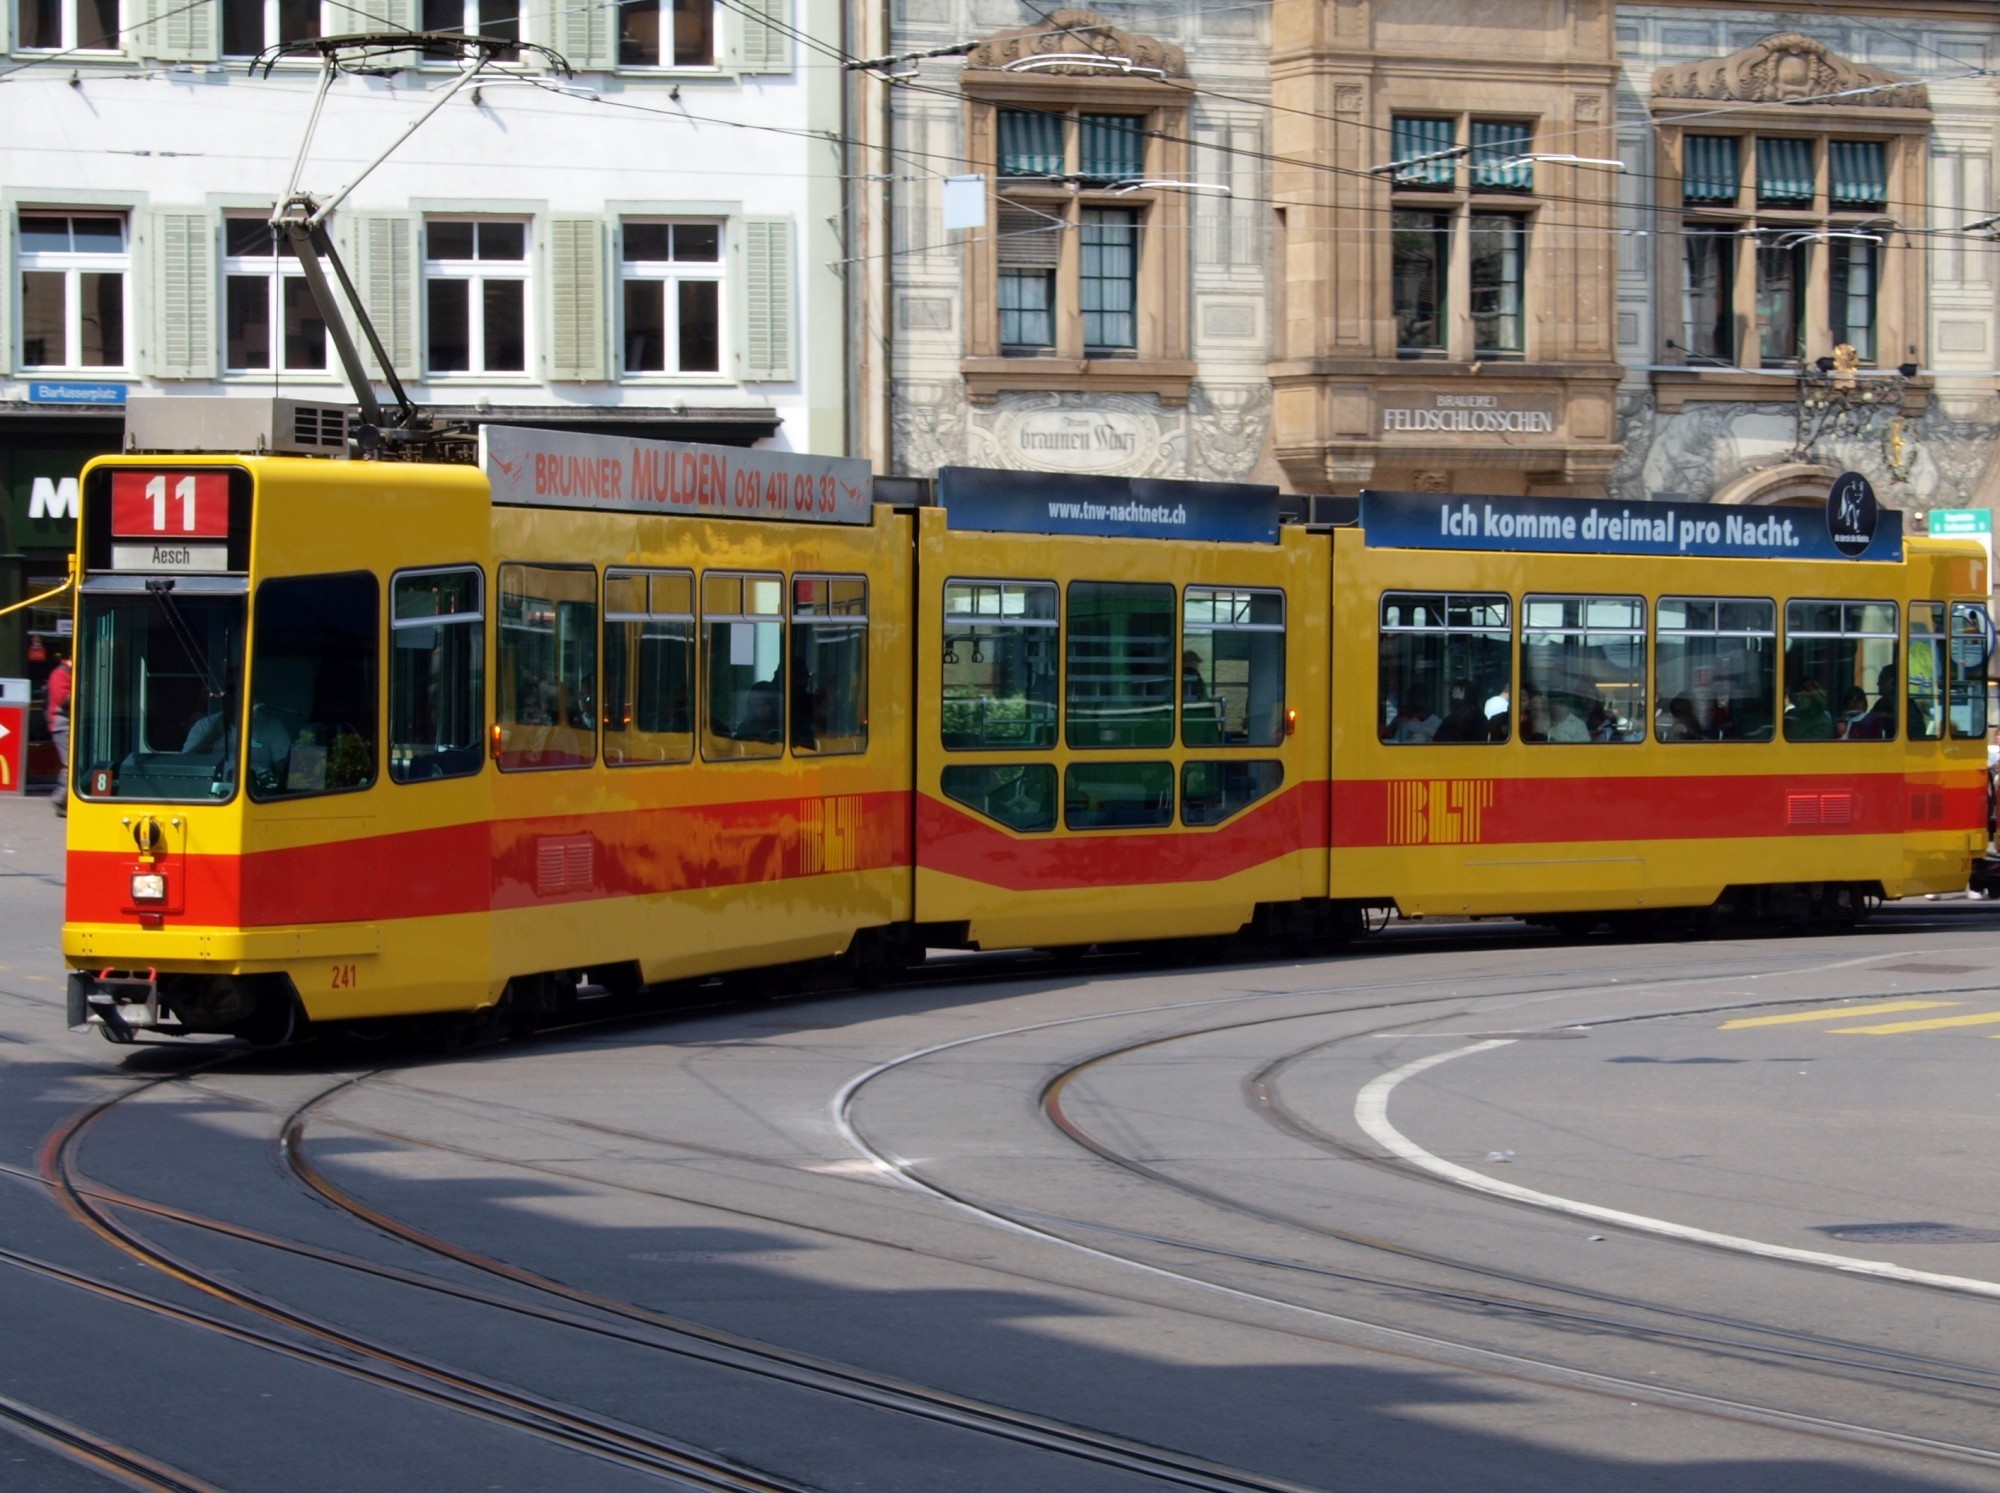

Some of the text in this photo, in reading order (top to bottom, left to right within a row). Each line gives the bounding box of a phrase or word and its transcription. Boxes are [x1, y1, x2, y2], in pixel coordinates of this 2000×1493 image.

[1436, 395, 1497, 408] BRAUEREI
[534, 446, 836, 514] BRUNNER MULDEN 061 411 03 33
[145, 475, 196, 531] 11
[1048, 501, 1186, 524] www.tnw-nachtnetz.ch
[1441, 504, 1800, 550] Ich komme dreimal pro Nacht.
[151, 546, 191, 565] Aesch
[97, 773, 107, 792] 8
[331, 965, 357, 990] 241
